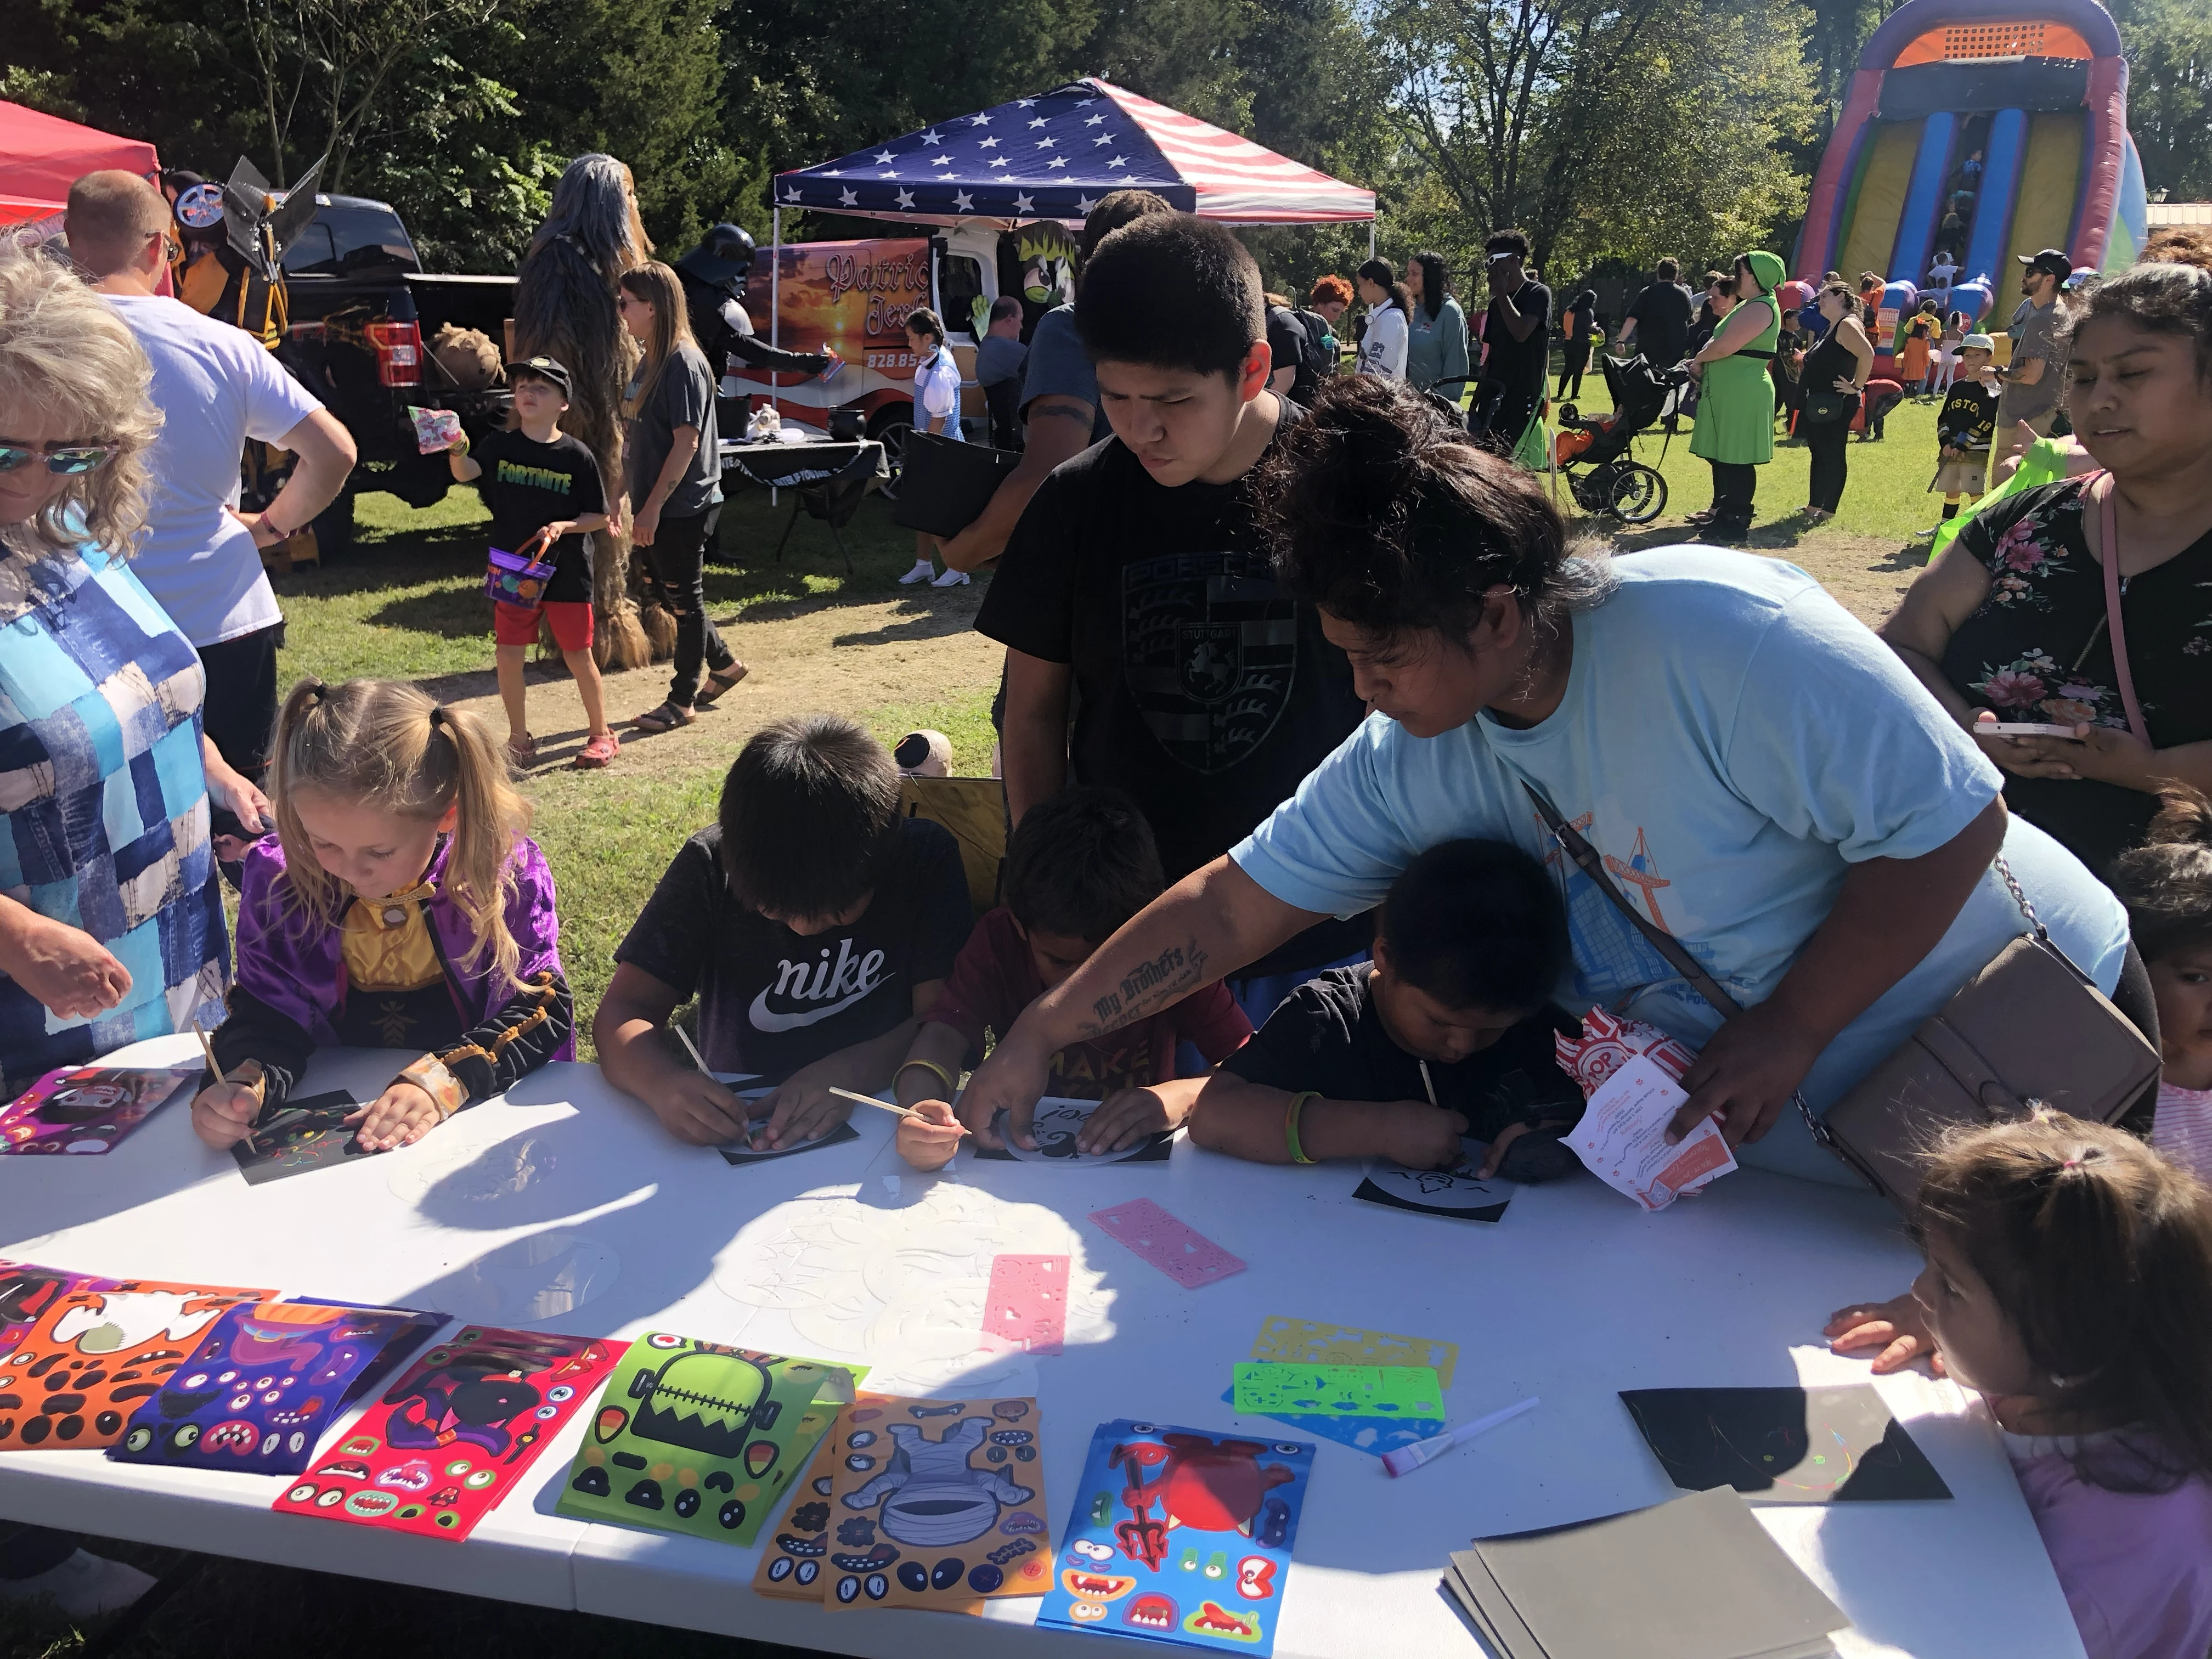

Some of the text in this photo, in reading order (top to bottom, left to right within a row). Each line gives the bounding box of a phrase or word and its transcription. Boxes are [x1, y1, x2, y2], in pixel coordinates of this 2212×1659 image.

[1977, 420, 1992, 432] 18
[497, 459, 572, 495] FORTNITE
[1182, 629, 1237, 640] STUTTGART
[774, 938, 884, 1000] nike
[1120, 947, 1184, 1004] Brothers
